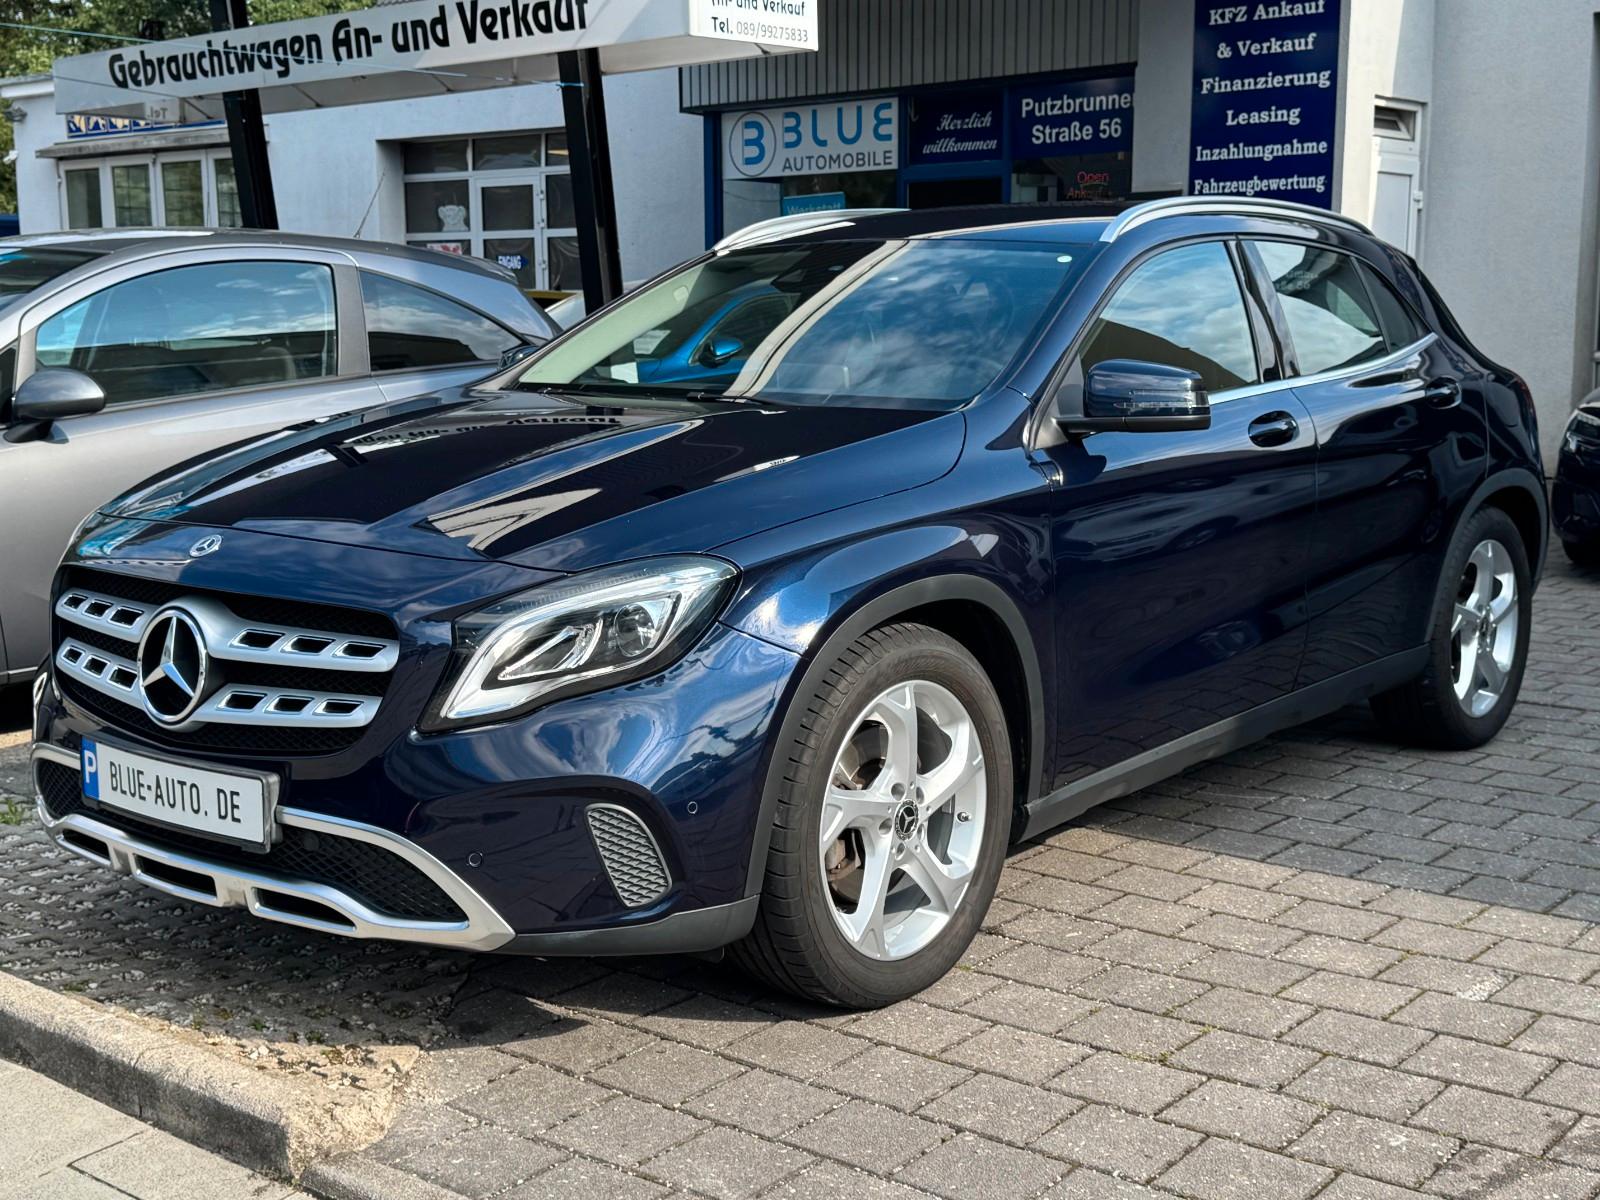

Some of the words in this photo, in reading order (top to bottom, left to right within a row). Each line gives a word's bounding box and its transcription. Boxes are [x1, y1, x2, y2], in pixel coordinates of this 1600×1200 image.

[762, 0, 805, 16] Verkauf
[1209, 6, 1247, 25] KFZ
[1253, 0, 1325, 20] Ankauf
[712, 16, 733, 34] Tel.
[736, 21, 808, 42] 089/99275833
[109, 32, 323, 88] Gebrauchtwagen
[332, 18, 383, 66] An-
[391, 4, 450, 53] und
[456, 0, 588, 44] Verkauf
[1217, 43, 1231, 58] &
[1237, 33, 1317, 56] Verkauf
[1201, 70, 1331, 94] Finanzierung
[1021, 92, 1133, 118] Putzbrunne
[1226, 107, 1301, 126] Leasing
[782, 102, 893, 149] BLUE
[936, 110, 992, 131] Herzlich
[1031, 121, 1093, 144] Straße
[1099, 118, 1122, 139] 56
[922, 137, 997, 154] willkommen
[1196, 139, 1327, 161] Inzahlungnahme
[782, 150, 893, 173] AUTOMOBILE
[1076, 170, 1110, 184] Open
[1194, 175, 1326, 196] Fahrzeugbewertung
[84, 749, 97, 783] P
